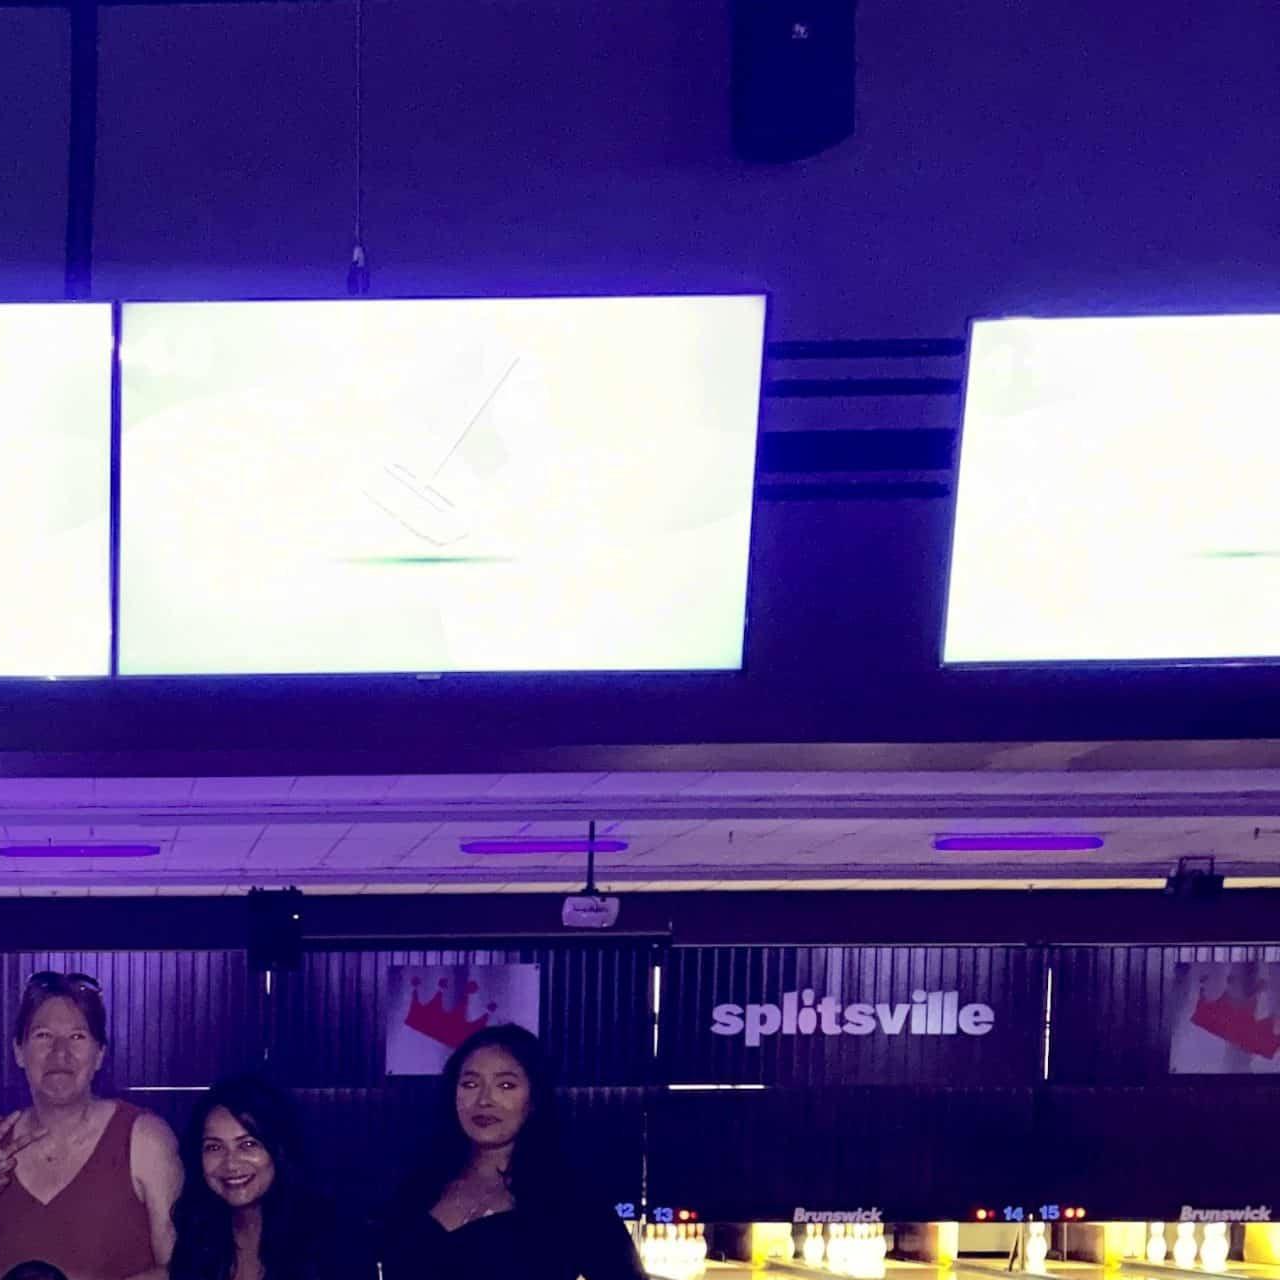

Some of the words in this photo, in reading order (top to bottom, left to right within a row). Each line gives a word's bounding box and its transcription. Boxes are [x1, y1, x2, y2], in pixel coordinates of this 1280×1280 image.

[710, 989, 995, 1046] splitsville
[615, 1203, 634, 1218] 12
[653, 1207, 673, 1222] 13
[793, 1207, 882, 1223] Brunswick
[1003, 1206, 1023, 1221] 14
[1039, 1205, 1060, 1219] 15
[1179, 1205, 1272, 1222] Brunswick
